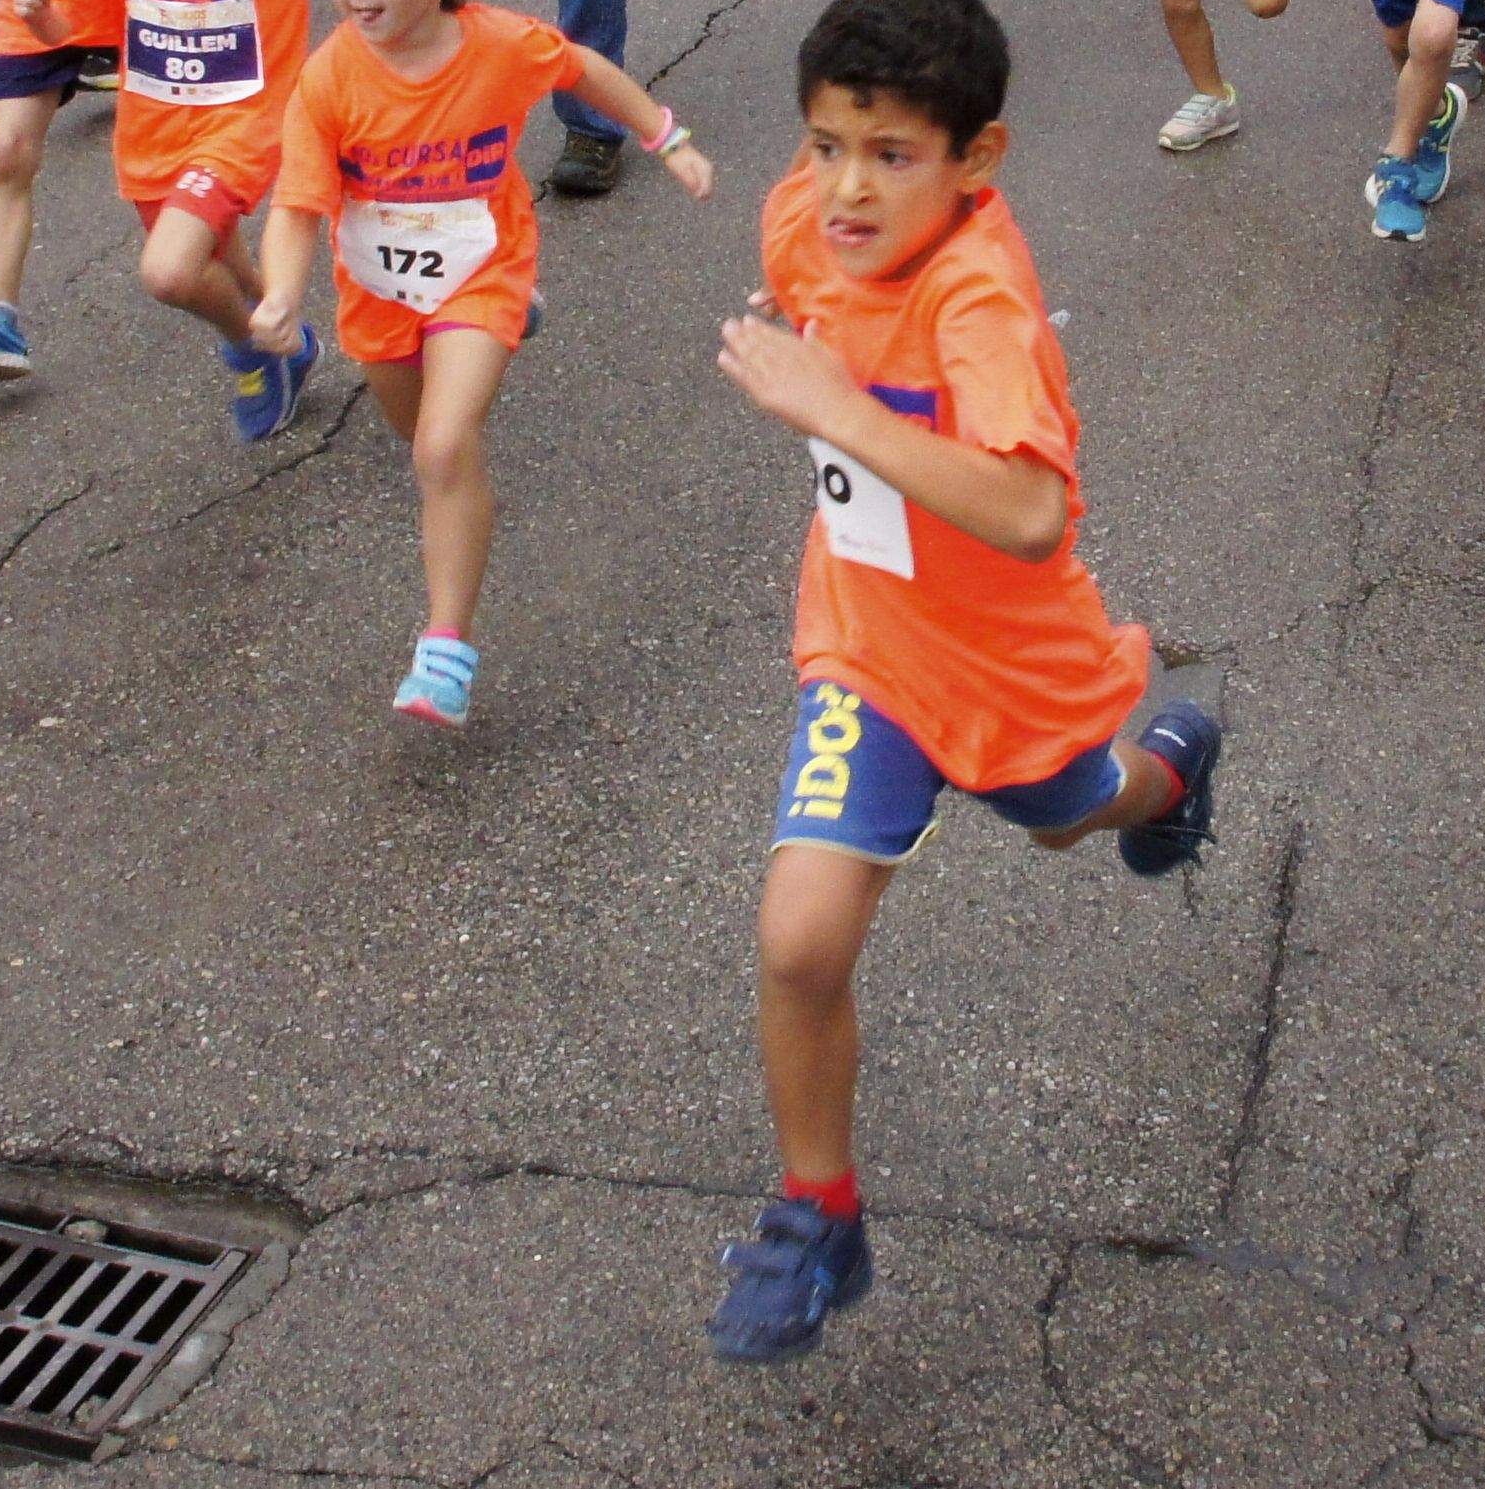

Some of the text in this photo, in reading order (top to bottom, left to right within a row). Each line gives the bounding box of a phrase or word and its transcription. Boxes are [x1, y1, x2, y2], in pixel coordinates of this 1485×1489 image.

[138, 28, 238, 54] GUILLEM
[165, 57, 206, 81] 80
[387, 140, 463, 169] CURSA
[377, 245, 445, 279] 172
